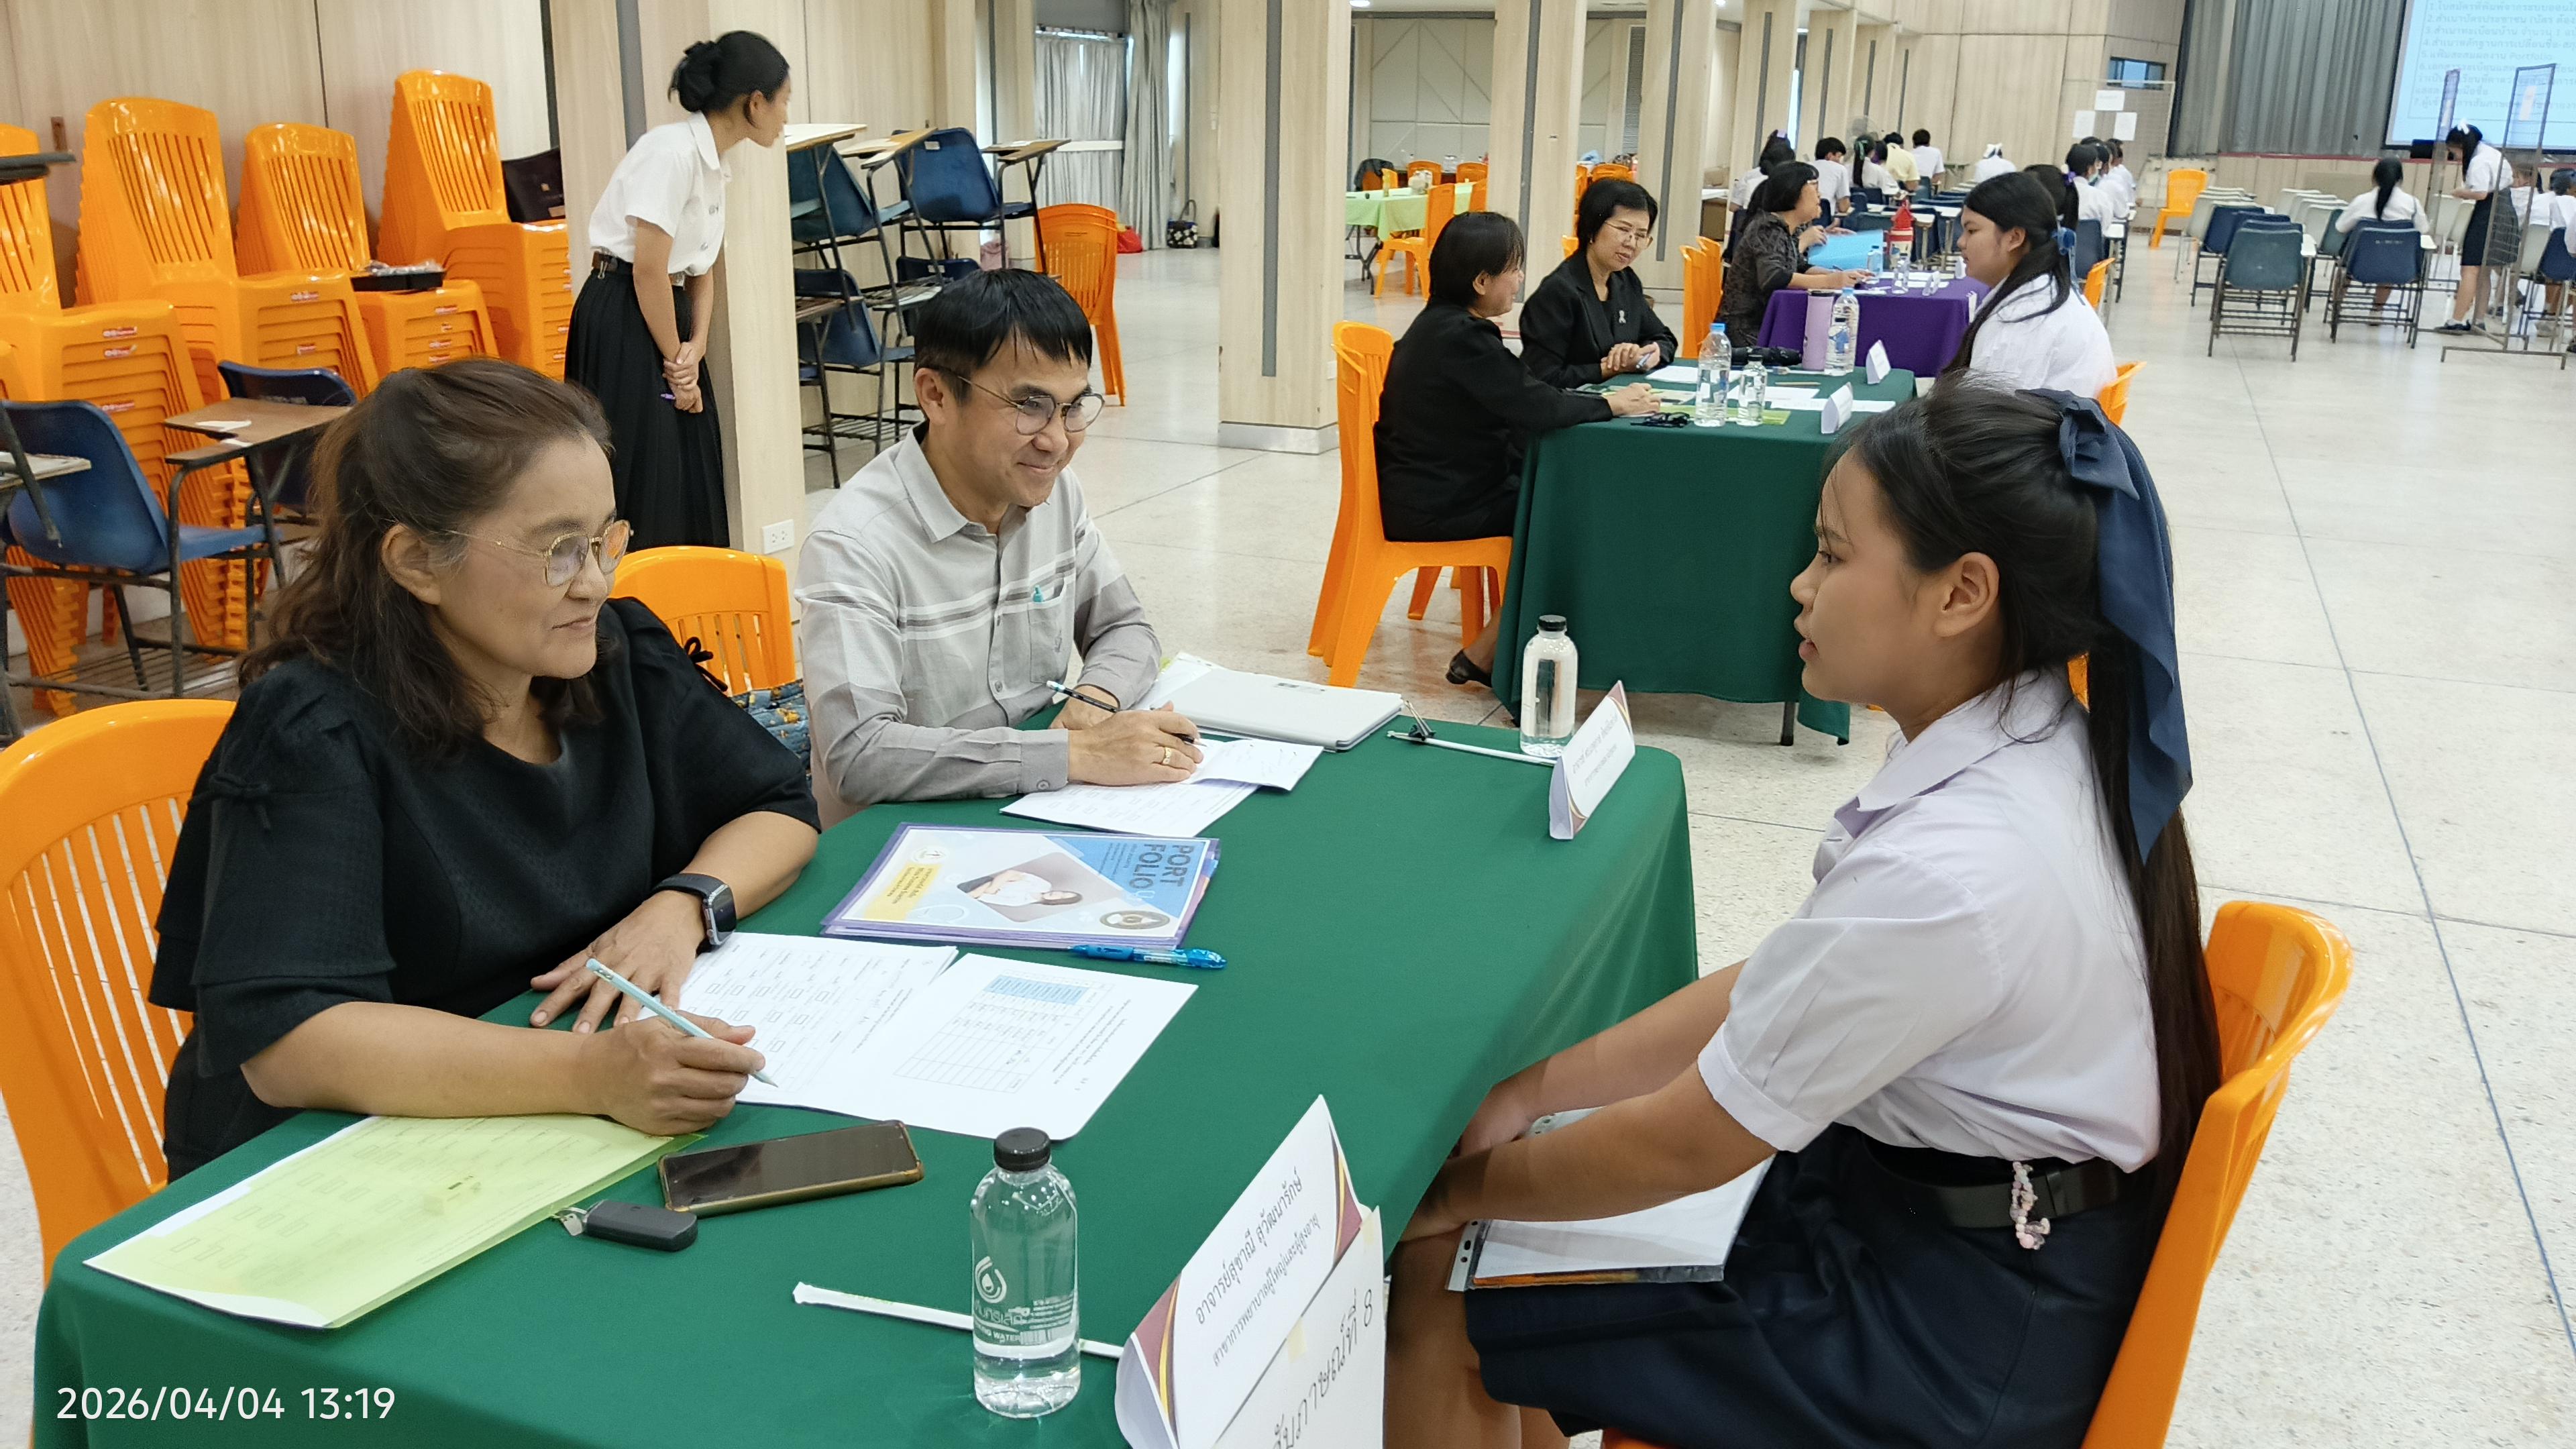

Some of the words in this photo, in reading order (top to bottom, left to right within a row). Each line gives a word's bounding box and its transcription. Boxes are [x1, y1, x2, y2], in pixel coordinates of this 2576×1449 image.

[1129, 843, 1167, 890] FOLIO
[1160, 844, 1195, 887] PORT
[1363, 1289, 1373, 1327] 8
